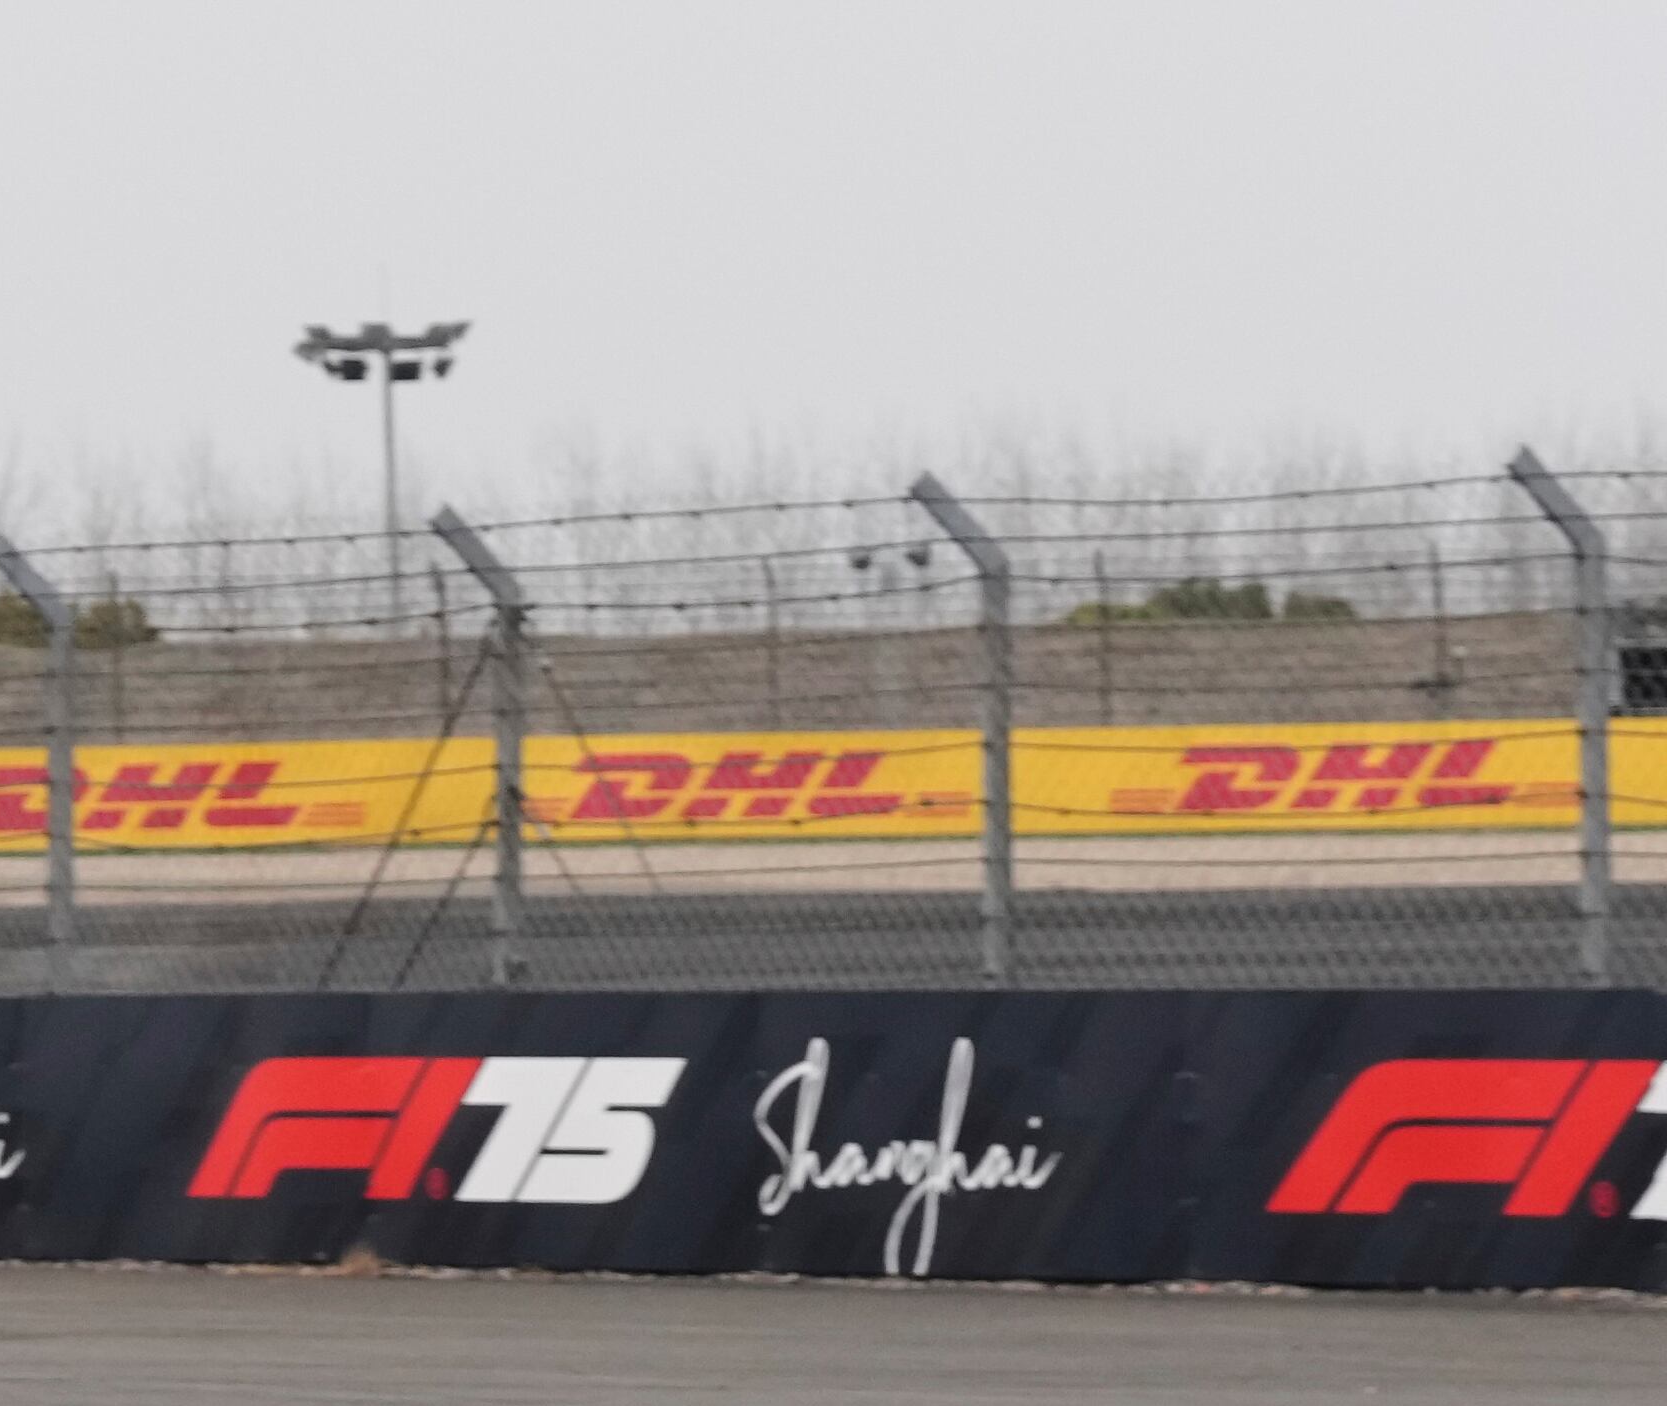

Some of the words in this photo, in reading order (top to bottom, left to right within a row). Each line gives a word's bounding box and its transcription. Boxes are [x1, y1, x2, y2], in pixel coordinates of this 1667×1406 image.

[572, 750, 904, 820] DHL
[1177, 738, 1514, 811] DHL
[752, 1037, 1063, 1275] Shanghai
